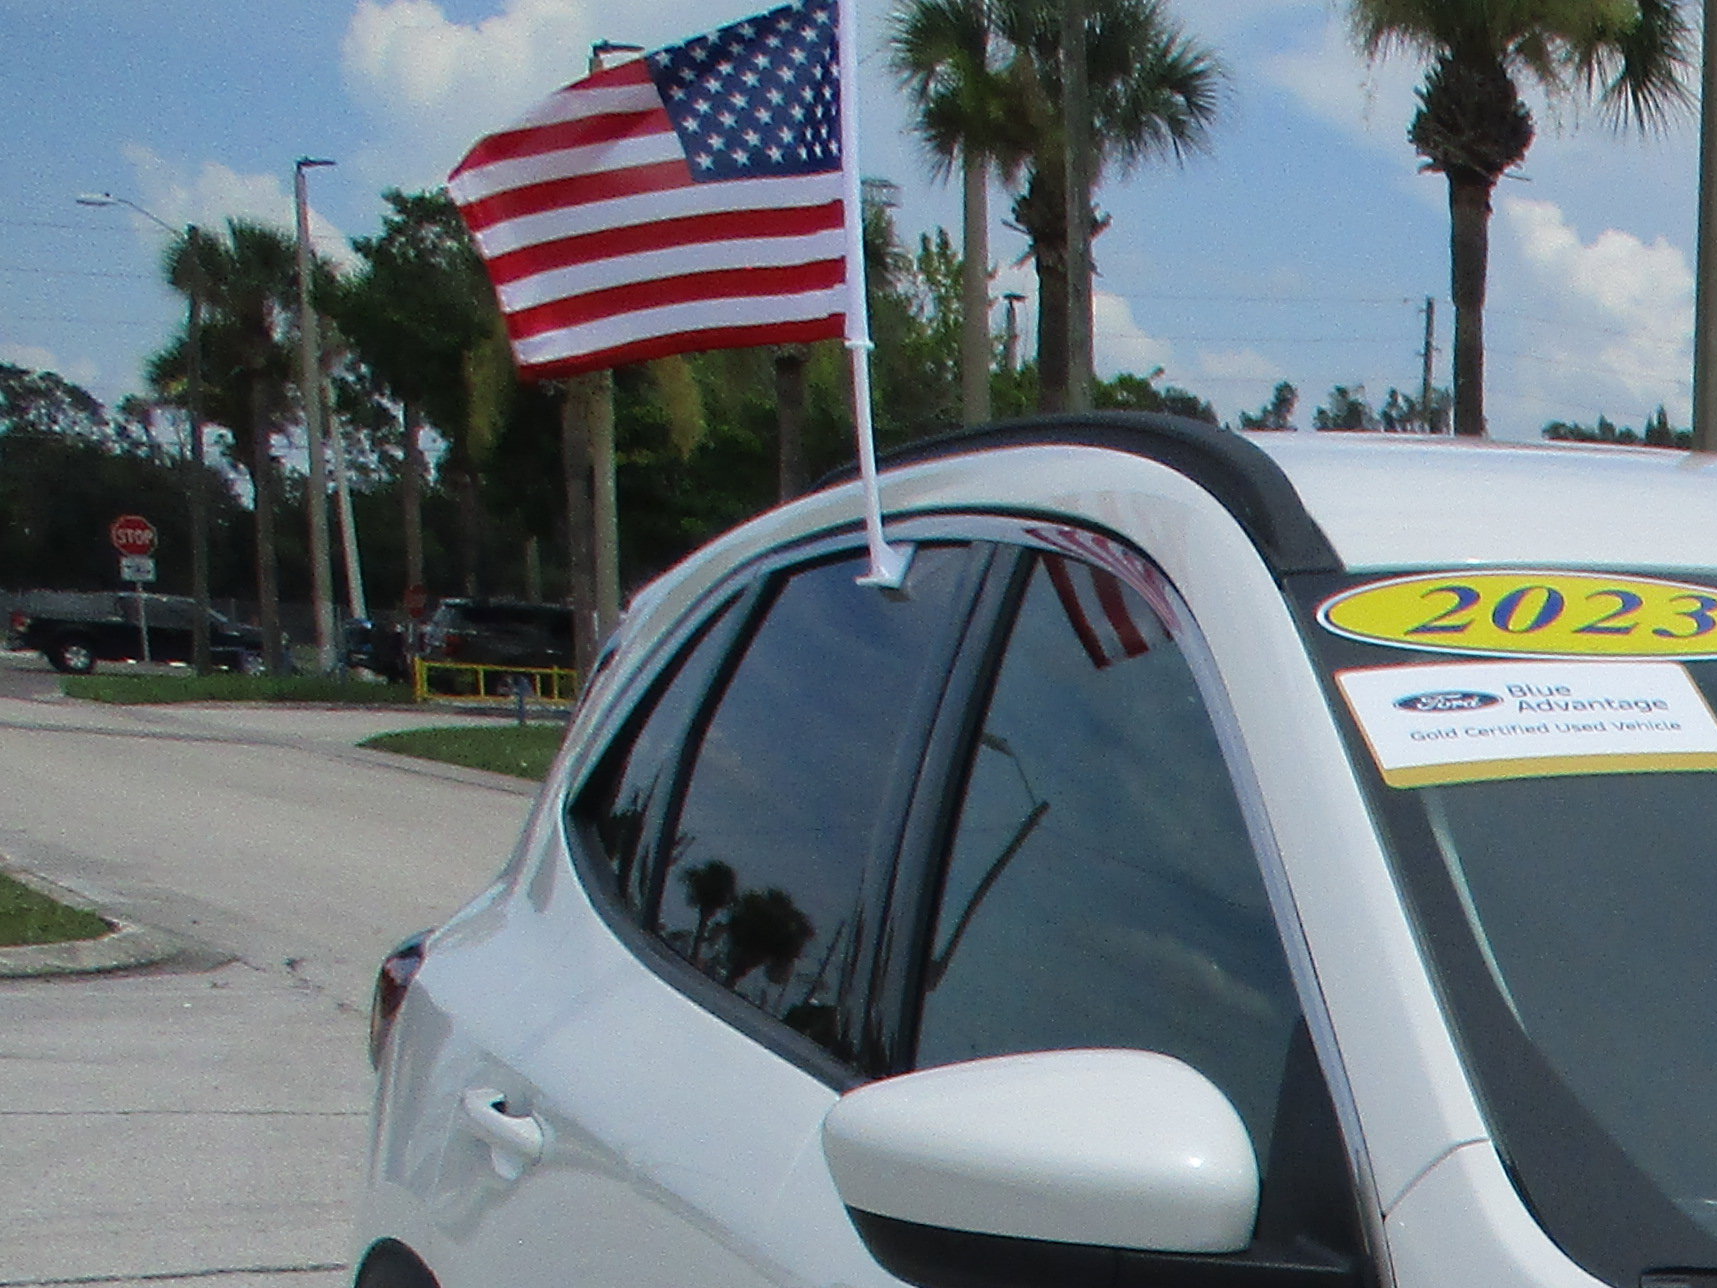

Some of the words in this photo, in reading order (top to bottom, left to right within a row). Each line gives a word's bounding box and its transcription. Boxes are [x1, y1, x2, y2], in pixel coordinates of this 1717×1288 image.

[116, 528, 154, 545] STOP
[1505, 683, 1573, 699] Blue
[1413, 689, 1486, 713] Ford
[1516, 695, 1670, 714] Advantage
[1409, 721, 1458, 743] Gold
[1464, 719, 1550, 740] Certified
[1557, 719, 1606, 735] Used
[1614, 718, 1682, 733] Vehicle
